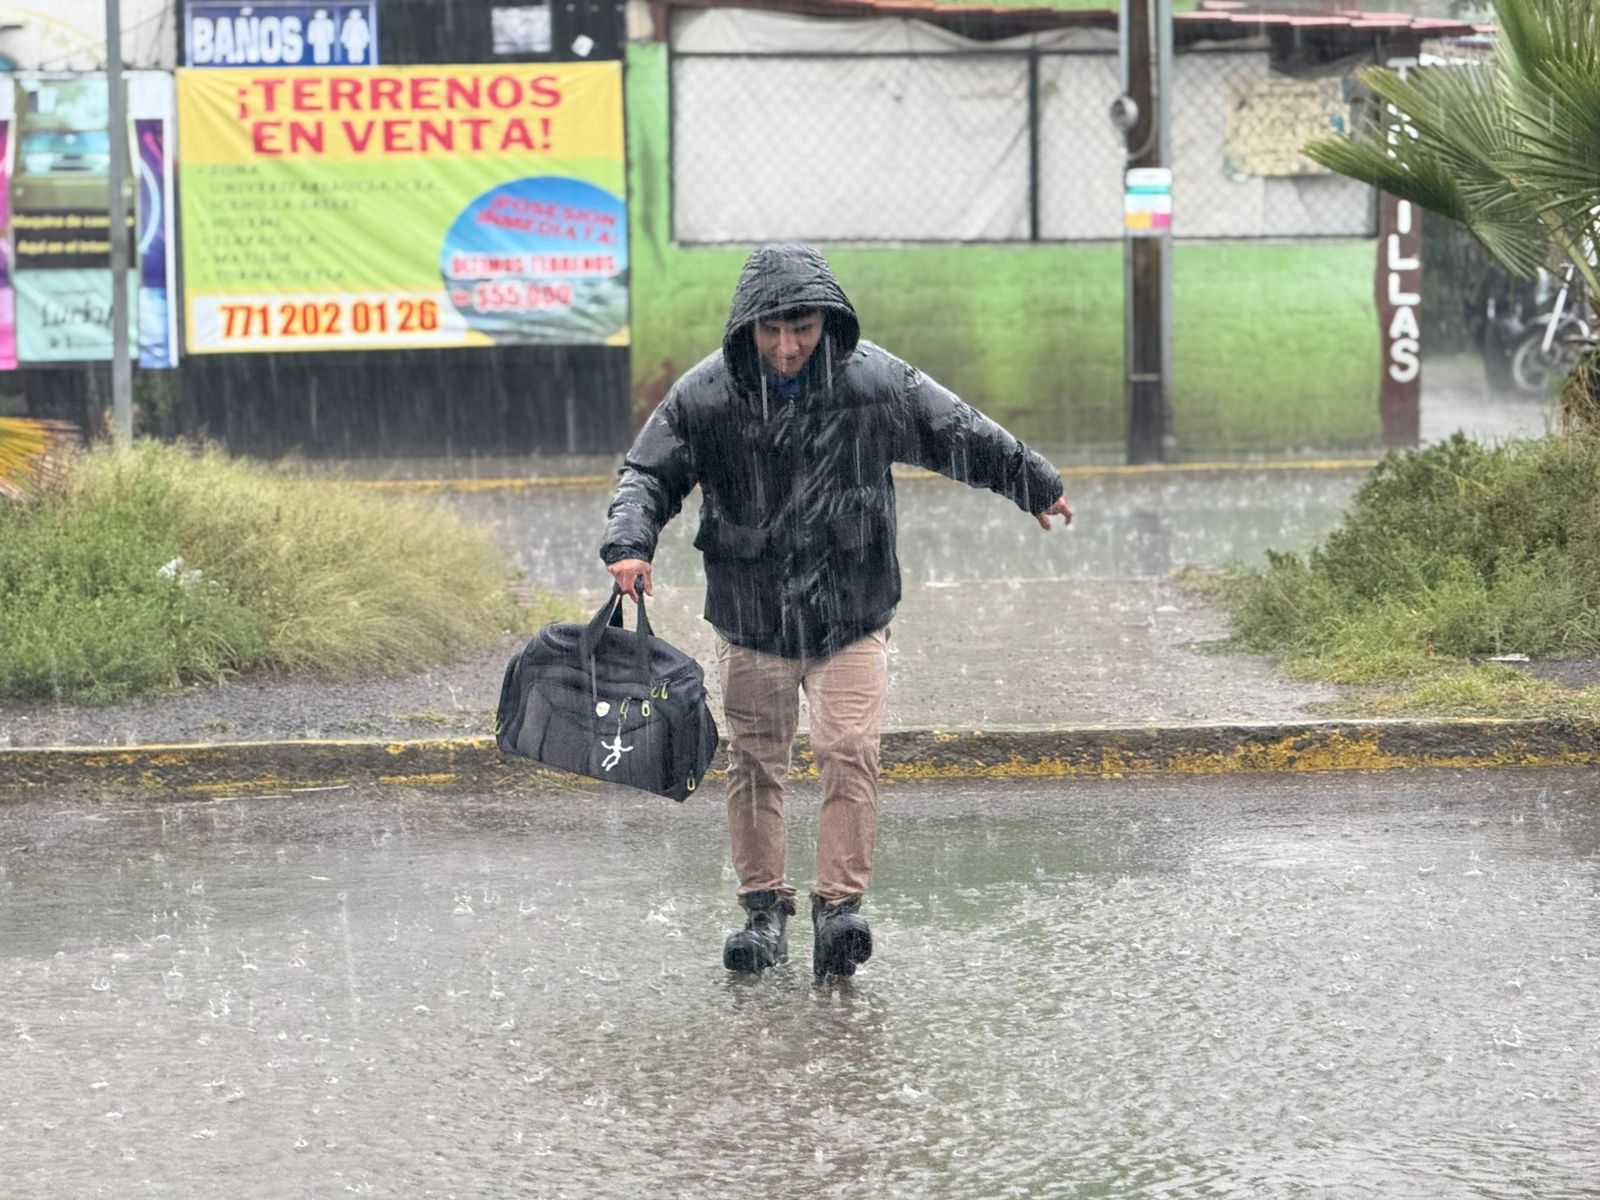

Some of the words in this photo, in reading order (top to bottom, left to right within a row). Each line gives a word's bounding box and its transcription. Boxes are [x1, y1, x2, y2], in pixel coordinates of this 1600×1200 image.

[193, 6, 304, 64] BAÑOS
[238, 75, 562, 119] ¡TERRENOS
[253, 121, 324, 154] EN
[341, 118, 551, 153] VENTA!
[220, 305, 269, 338] 771
[281, 303, 342, 335] 202
[353, 302, 387, 333] 01
[398, 300, 438, 332] 26
